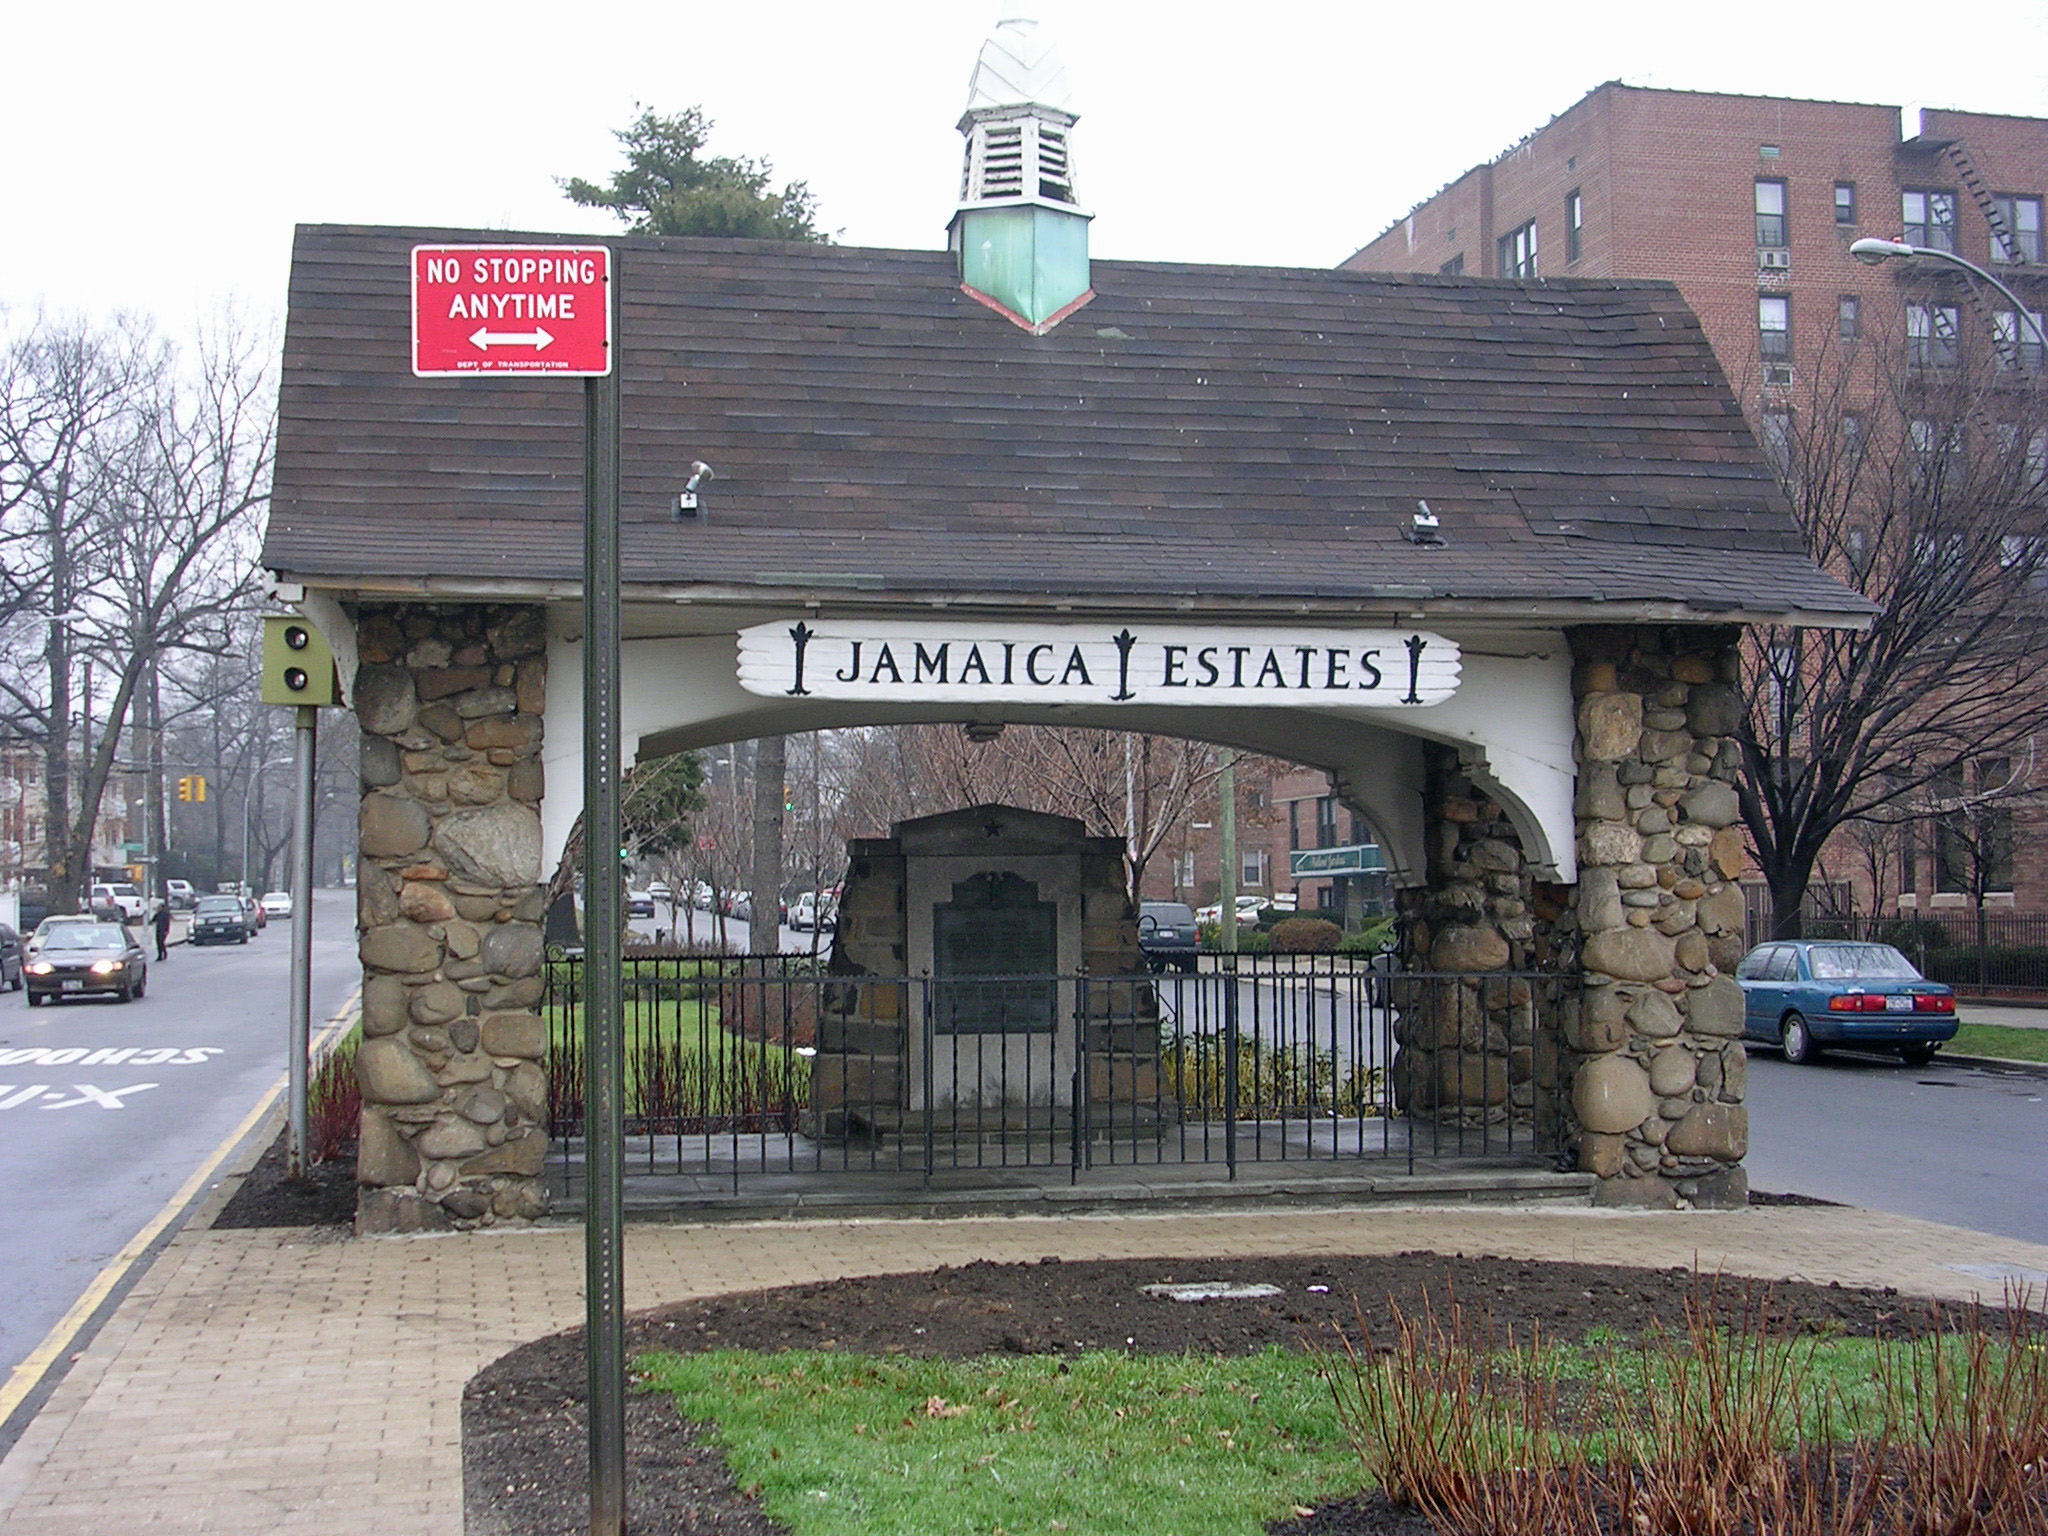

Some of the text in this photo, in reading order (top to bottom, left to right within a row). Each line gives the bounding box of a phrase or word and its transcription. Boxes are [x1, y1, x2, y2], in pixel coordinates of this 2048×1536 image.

[427, 258, 595, 284] NO STOPPING
[449, 293, 575, 319] ANYTIME
[836, 641, 1382, 690] JAMAICA ESTATES
[0, 1047, 224, 1065] SCHOO
